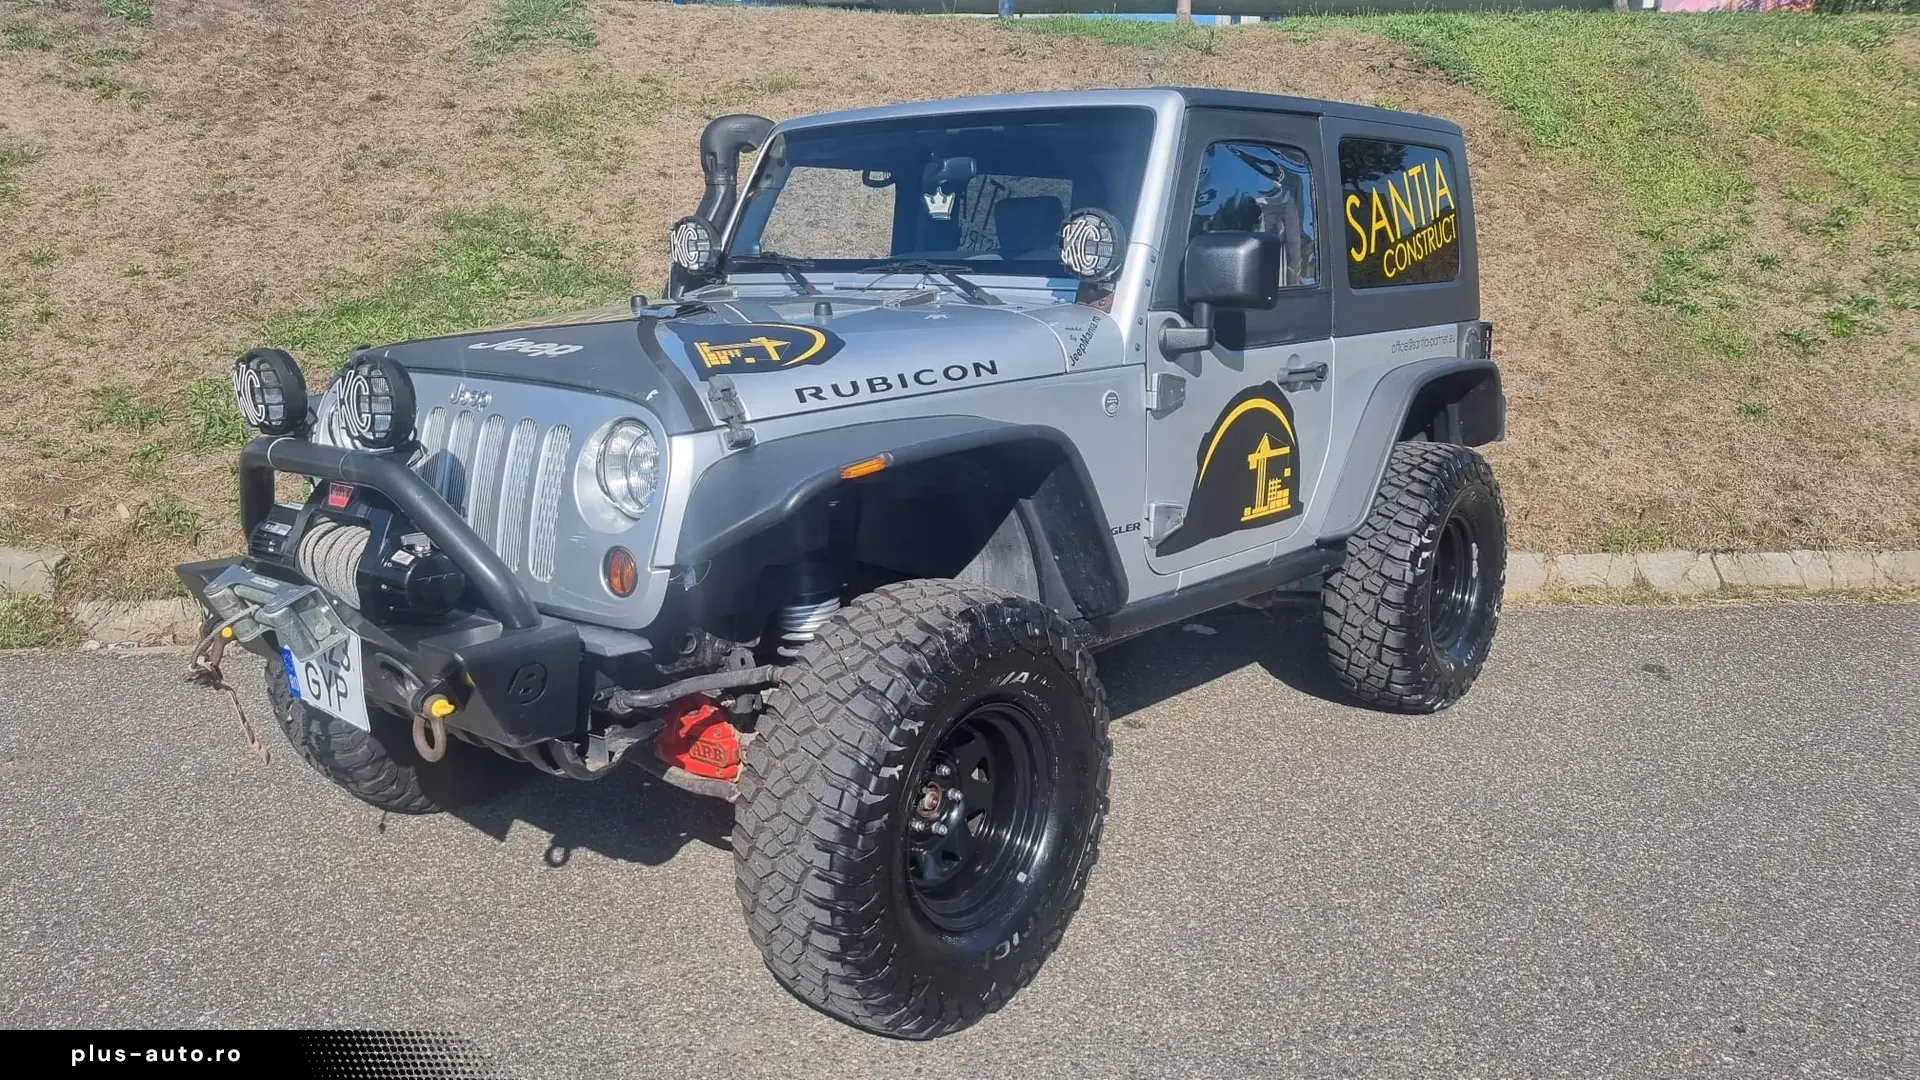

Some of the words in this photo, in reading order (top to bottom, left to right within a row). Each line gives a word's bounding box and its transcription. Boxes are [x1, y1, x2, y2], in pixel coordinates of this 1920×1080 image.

[1346, 157, 1456, 262] SANTIA
[670, 224, 699, 269] KC
[1061, 218, 1101, 273] KC
[1383, 213, 1456, 278] CONSTRUCT
[468, 337, 584, 358] Jeep
[1069, 315, 1101, 367] JeepMania.ro
[233, 364, 266, 426] KC
[336, 369, 372, 437] KC
[450, 382, 492, 412] Jeep
[794, 359, 998, 404] RUBICON
[304, 661, 349, 713] GYP
